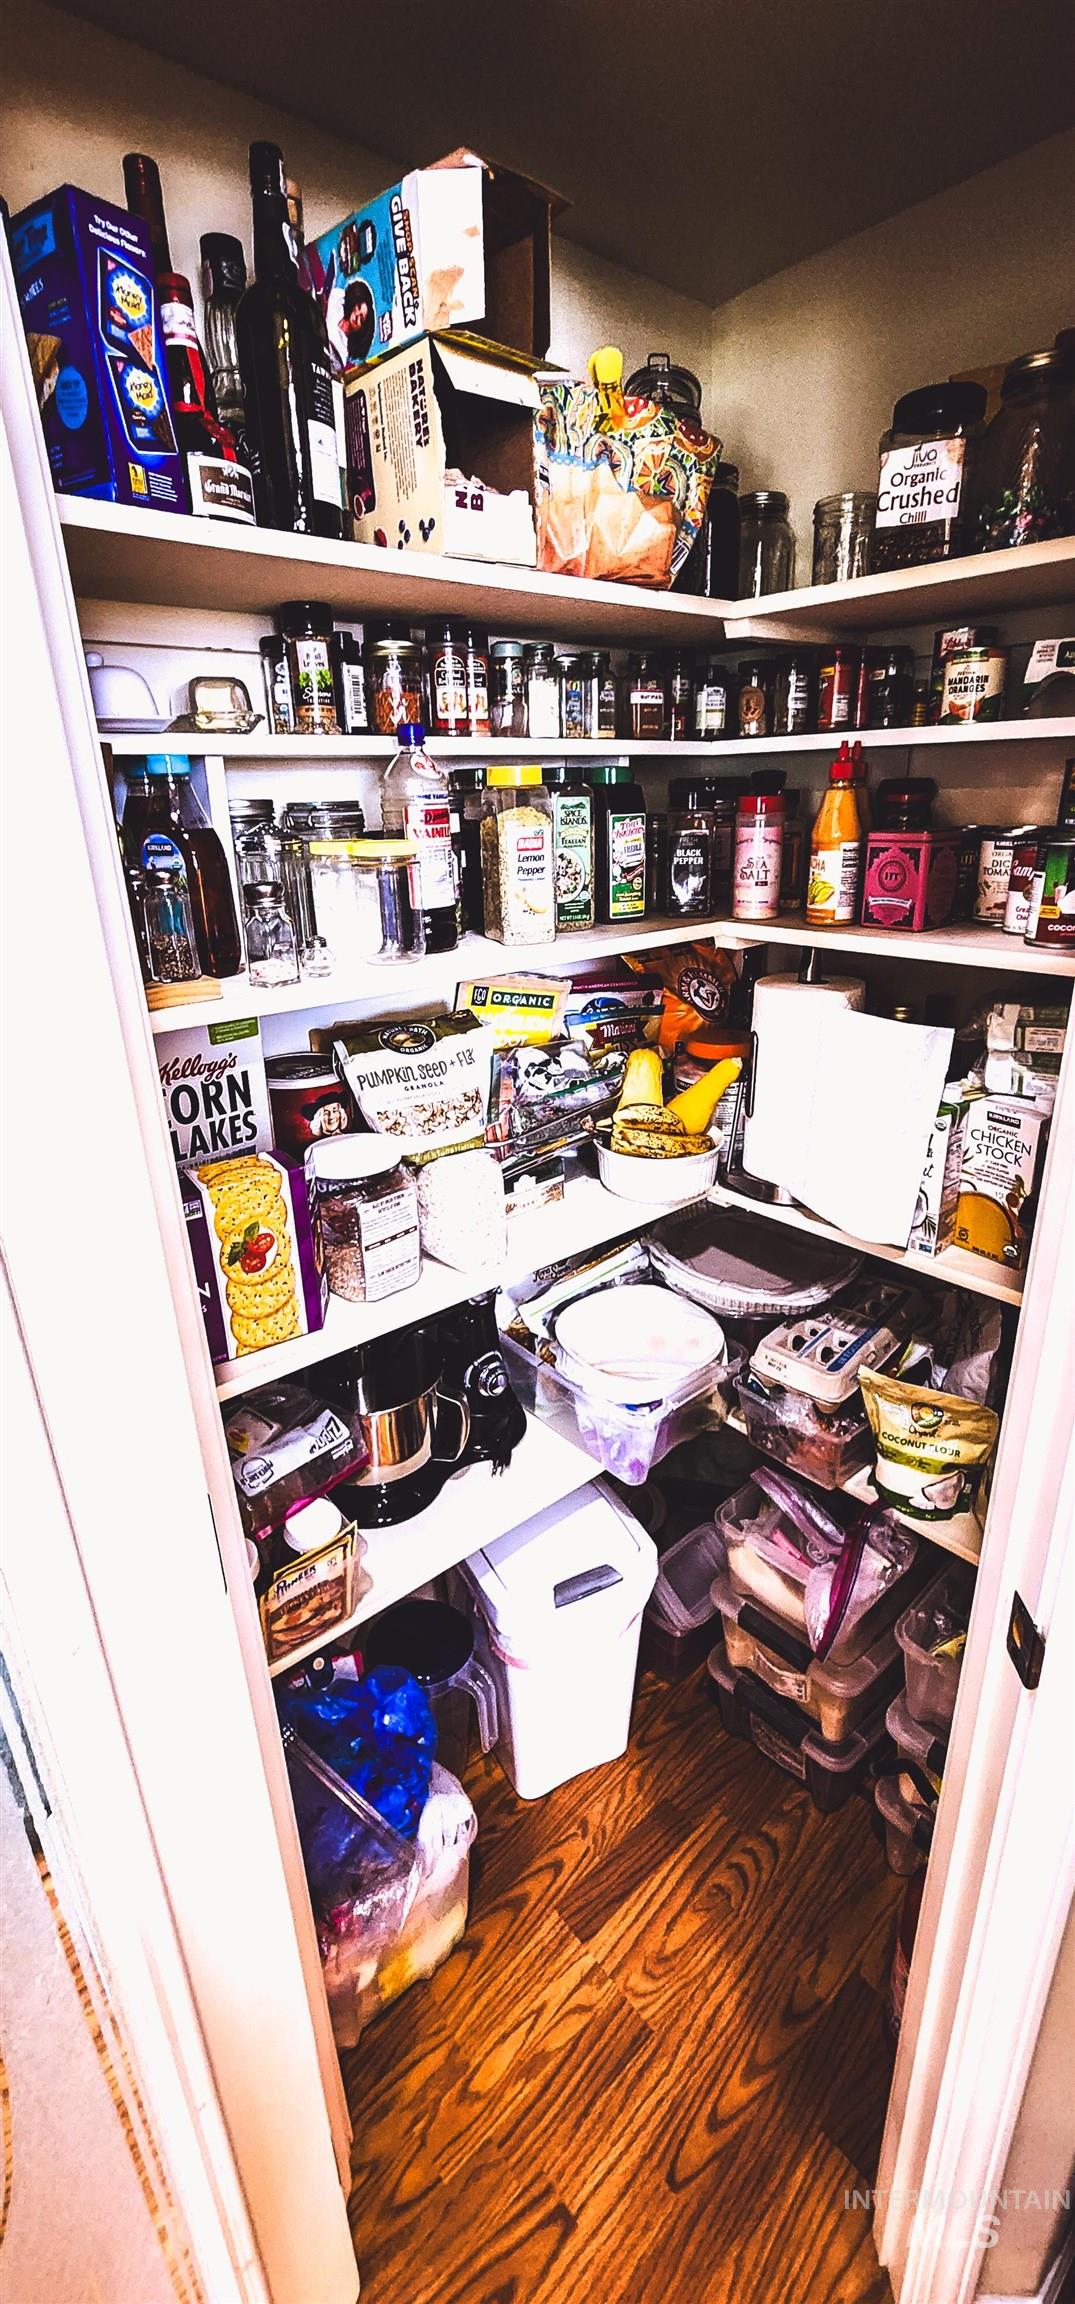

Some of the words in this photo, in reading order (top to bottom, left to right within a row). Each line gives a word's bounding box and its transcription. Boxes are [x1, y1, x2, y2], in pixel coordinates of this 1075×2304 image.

[389, 193, 409, 258] GIVE
[396, 257, 417, 329] BACK
[408, 361, 424, 449] BAKERY
[890, 466, 948, 488] Organic
[877, 481, 960, 513] Crushed
[899, 510, 928, 525] Chilli
[947, 674, 990, 686] MANDARIN
[948, 683, 986, 695] ORANGES
[560, 815, 588, 826] ISLANDS
[564, 809, 583, 818] SPICE
[561, 837, 587, 846] ITALIAN
[517, 854, 545, 863] Lemon
[676, 848, 702, 857] BLACK
[673, 857, 704, 865] PEPPER
[746, 857, 768, 869] SEA
[516, 865, 546, 877] Pepper
[739, 866, 771, 881] SALT
[491, 991, 552, 1007] ORGANIC
[399, 1043, 429, 1054] ORGANIC
[160, 1052, 238, 1086] Kellogg's
[403, 1080, 445, 1092] GRANOLA
[163, 1070, 252, 1129] ORN
[988, 1113, 1020, 1126] KIRKLAND
[987, 1124, 1019, 1139] ORGANIC
[970, 1128, 1033, 1157] CHICKEN
[975, 1143, 1023, 1168] STOCK
[881, 1431, 927, 1450] COCONUT
